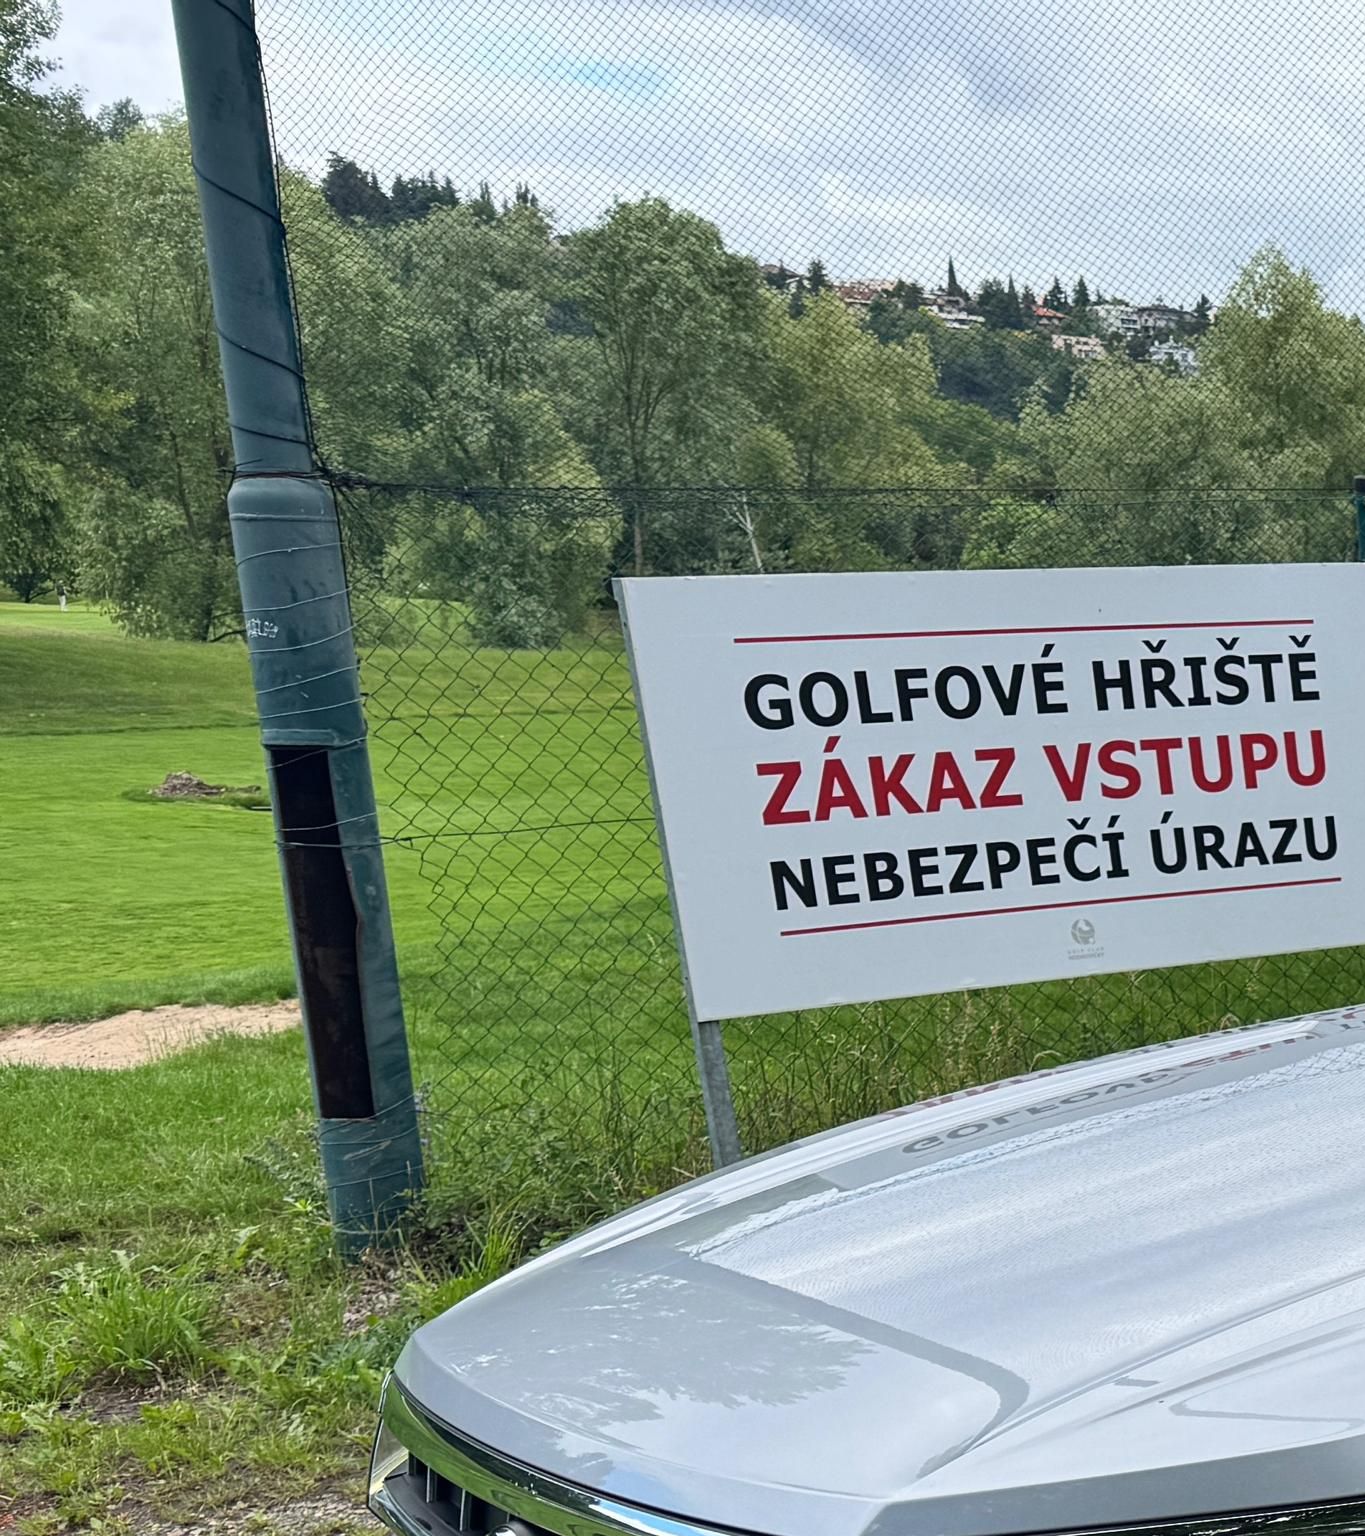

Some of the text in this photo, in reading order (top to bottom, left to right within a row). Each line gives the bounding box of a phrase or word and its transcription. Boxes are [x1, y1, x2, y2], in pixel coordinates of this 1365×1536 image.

[744, 634, 1321, 731] GOLFOVÉ HŘIŠTĚ
[756, 729, 1327, 826] ZÁKAZ VSTUPU
[769, 811, 1339, 911] NEBEZPEČÍ ÚRAZU
